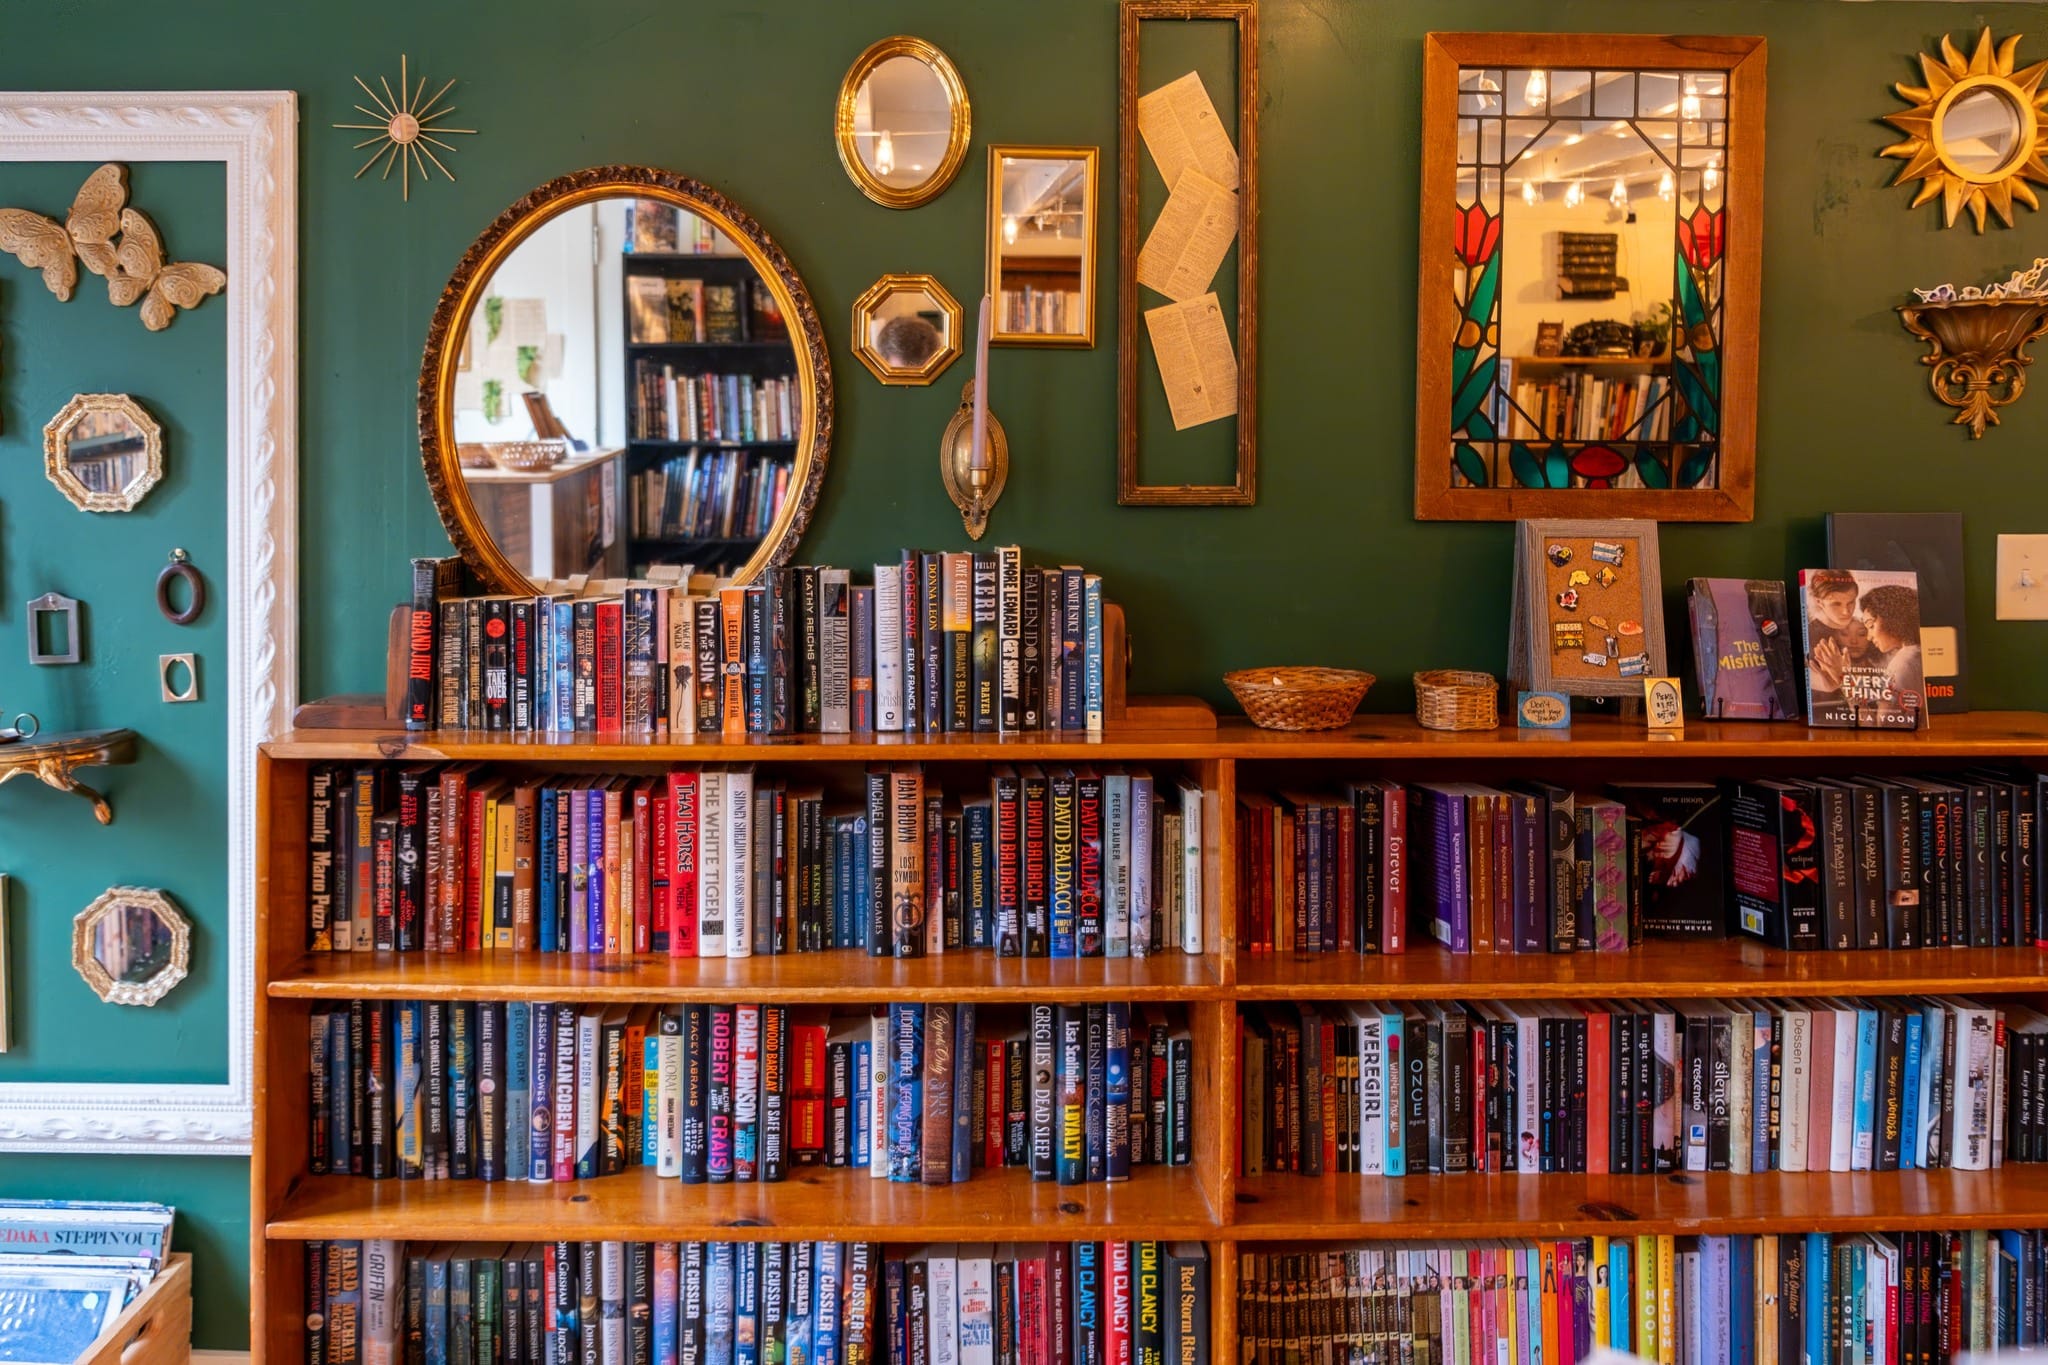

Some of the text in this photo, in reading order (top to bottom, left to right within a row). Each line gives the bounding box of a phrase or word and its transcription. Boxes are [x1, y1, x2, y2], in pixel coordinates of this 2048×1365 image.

[699, 604, 715, 634] CITY
[805, 575, 814, 660] KATHY REICHS
[905, 560, 916, 639] NO RESERVE
[929, 564, 937, 631] DONNA LEON
[975, 572, 995, 622] KERR
[1003, 551, 1018, 636] ELMORE LEONARD
[411, 611, 432, 651] GRAND
[729, 620, 738, 657] LEE CHILD
[1088, 592, 1099, 708] Run Ann Patchett
[1733, 640, 1760, 652] The
[411, 652, 430, 680] JURY
[487, 670, 507, 687] TAKE
[700, 651, 715, 682] SUN
[1002, 640, 1018, 699] GET SHORTY
[1719, 653, 1766, 671] Misfits
[1843, 675, 1892, 686] EVERY
[487, 686, 507, 700] OVER
[981, 681, 990, 715] PRAYER
[1531, 700, 1555, 712] Don't
[1843, 687, 1893, 701] THING
[1880, 714, 1915, 722] YOON
[677, 783, 695, 873] THAI HORSE
[734, 791, 746, 859] SIDNEY SHELDON
[872, 778, 883, 824] MICHAEL
[898, 780, 917, 843] DAN BROWN
[1112, 793, 1120, 860] PETER BLAUNER
[1977, 806, 1987, 848] TEMPTED
[311, 773, 331, 928] The Family Mario Puzo
[705, 775, 719, 918] THE WHITE TIGER
[872, 827, 883, 868] DIBDIN
[1000, 802, 1016, 906] DAVID BALDACCI
[1028, 801, 1043, 900] DAVID BALDACCI
[1054, 796, 1071, 914] DAVID BALDACCI
[1834, 793, 1845, 887] BLOOD PROMISE
[1901, 795, 1910, 885] LAST SACRIFICE
[1922, 810, 1932, 866] BETRAYED
[1936, 803, 1948, 856] CHOSEN
[1954, 806, 1963, 859] UNTAMED
[1081, 800, 1098, 917] DAVID BALDACCI
[1389, 836, 1403, 893] forever
[1792, 856, 1813, 867] eclipse
[1119, 886, 1125, 897] OF
[456, 1009, 464, 1074] MICHAEL CONNELLY
[483, 1011, 492, 1075] MICHAEL CONNELLY
[537, 1012, 546, 1102] JESSICA FELLOWES
[583, 1028, 592, 1087] HARLAN COBEN
[690, 1011, 699, 1107] STACEY ABRAMS
[713, 1012, 729, 1084] ROBERT
[735, 1009, 758, 1123] CRAIG JOHNSON
[766, 1009, 779, 1092] LINWOOD BARCLAY
[1089, 1024, 1100, 1106] GLENN BECK
[1621, 1030, 1629, 1086] dark flame
[1638, 1033, 1649, 1060] night
[1794, 1018, 1805, 1064] Dessen
[557, 1027, 575, 1130] HARLAN COBEN
[1364, 1022, 1380, 1122] WEREGIRL
[1410, 1059, 1423, 1116] ONCE
[1693, 1058, 1704, 1111] crescendo
[1714, 1061, 1729, 1115] silence
[2021, 1070, 2030, 1087] Lucy
[2023, 1089, 2029, 1097] in
[712, 1115, 728, 1168] CRAIS
[767, 1096, 780, 1162] NO SAFE HOUSE
[1035, 1089, 1049, 1159] DEAD SLEEP
[1064, 1105, 1080, 1159] LOYALTY
[1324, 1093, 1334, 1142] LIONBOY
[2021, 1111, 2030, 1125] Sky
[343, 1248, 358, 1291] HARD
[369, 1253, 385, 1301] GRIFFIN
[559, 1261, 569, 1305] GRISHAM
[1142, 1241, 1156, 1270] TOM
[584, 1250, 596, 1348] SUMMONS JOHN
[687, 1270, 700, 1318] CUSSLER
[767, 1271, 781, 1322] CUSSLER
[797, 1270, 809, 1315] CUSSLER
[819, 1275, 834, 1331] CUSSLER
[851, 1274, 865, 1330] CUSSLER
[1080, 1270, 1095, 1329] CLANCY
[1113, 1241, 1127, 1333] TOM CLANCY
[1142, 1274, 1156, 1333] CLANCY
[1181, 1266, 1195, 1333] Red Storm
[1787, 1258, 1800, 1313] Girl Online
[1856, 1295, 1864, 1319] hokey
[343, 1302, 357, 1362] MICHAEL
